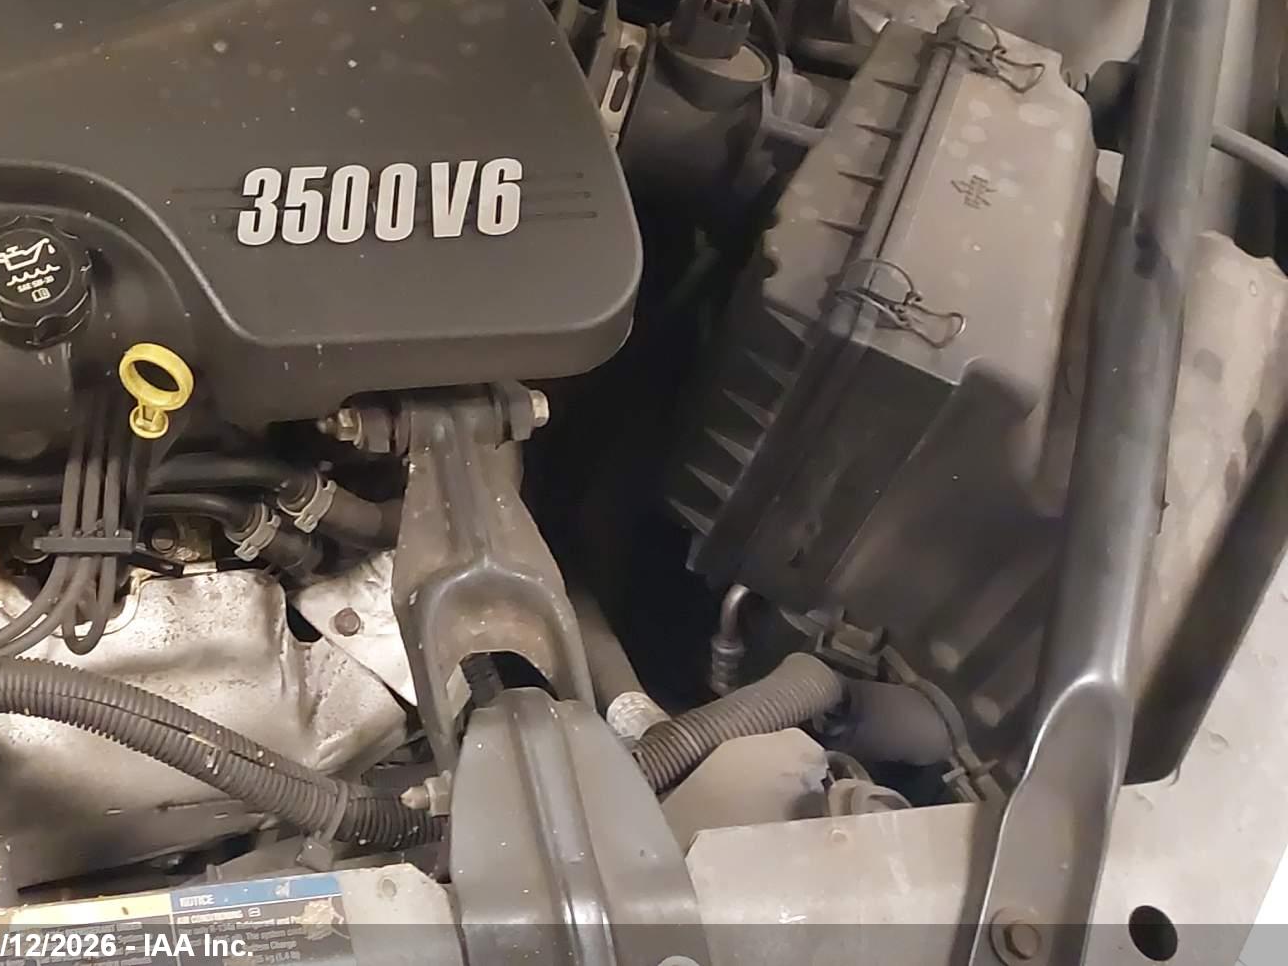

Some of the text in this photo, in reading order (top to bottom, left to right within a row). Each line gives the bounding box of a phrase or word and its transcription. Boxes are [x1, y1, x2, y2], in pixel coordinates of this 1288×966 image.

[237, 157, 523, 246] 3500 V6
[179, 894, 215, 907] NOTICE
